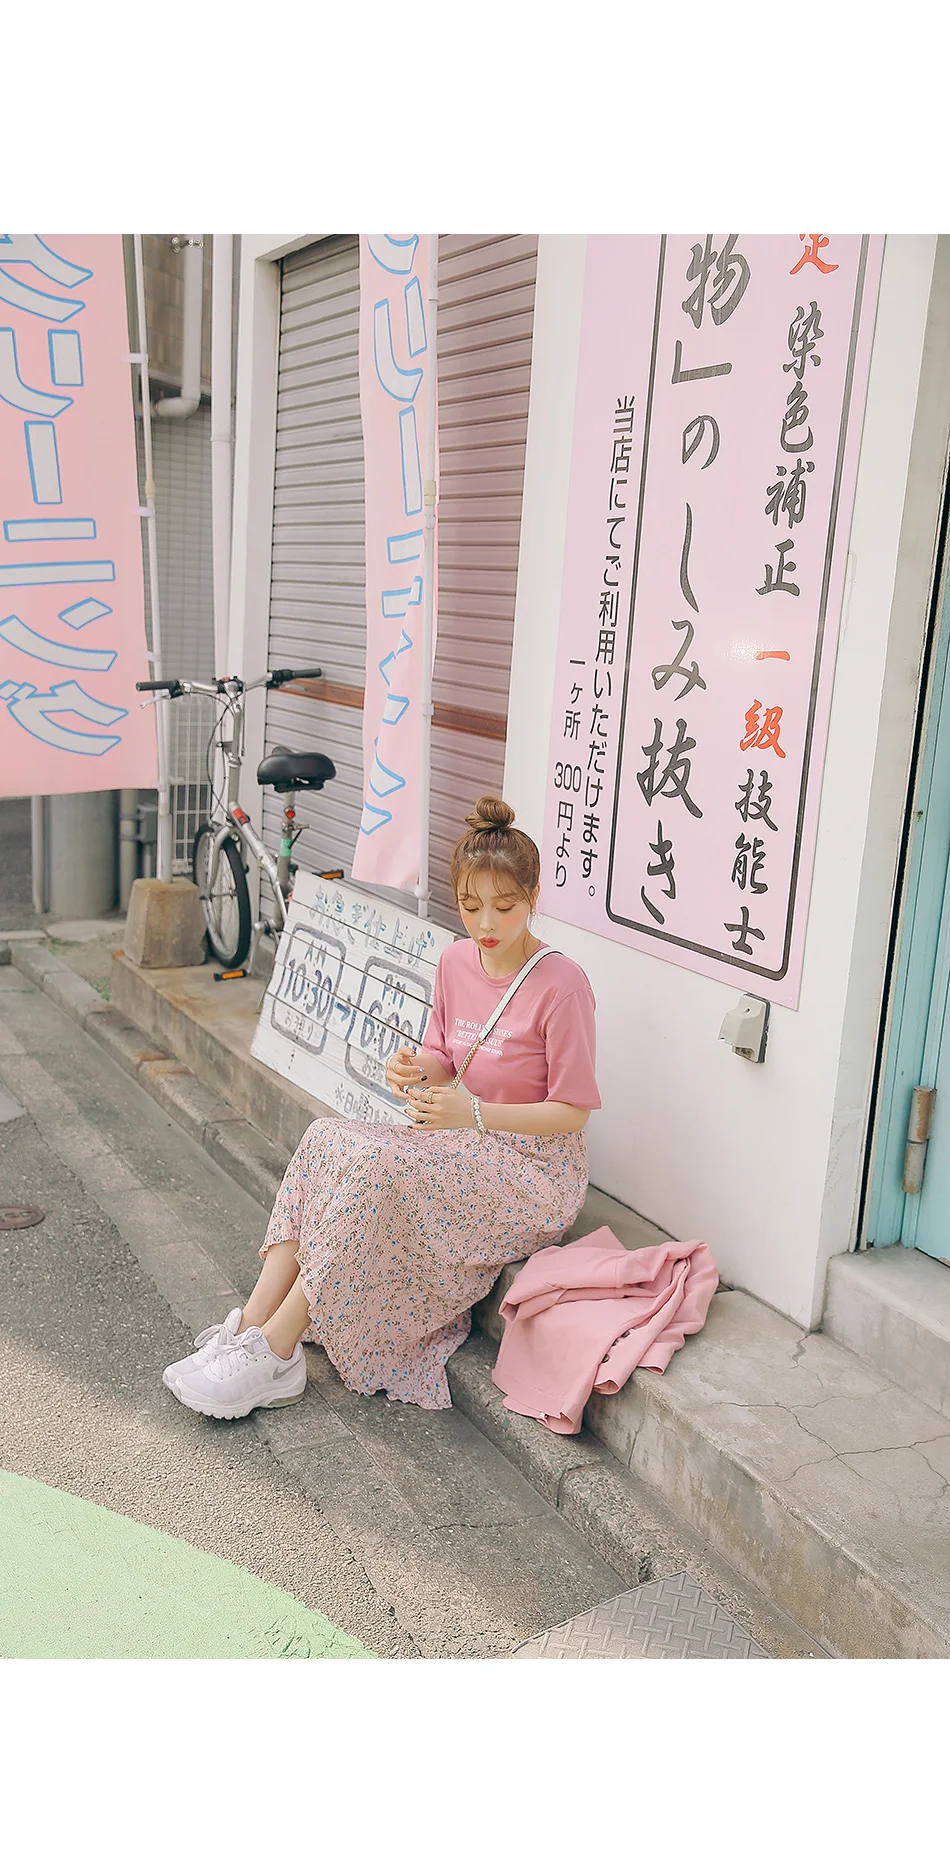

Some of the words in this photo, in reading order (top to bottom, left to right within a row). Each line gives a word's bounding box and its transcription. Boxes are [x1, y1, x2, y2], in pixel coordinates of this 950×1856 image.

[579, 395, 636, 898] 当店にてご利用いただけます。
[283, 958, 333, 1021] 10:30
[454, 1018, 466, 1028] THE
